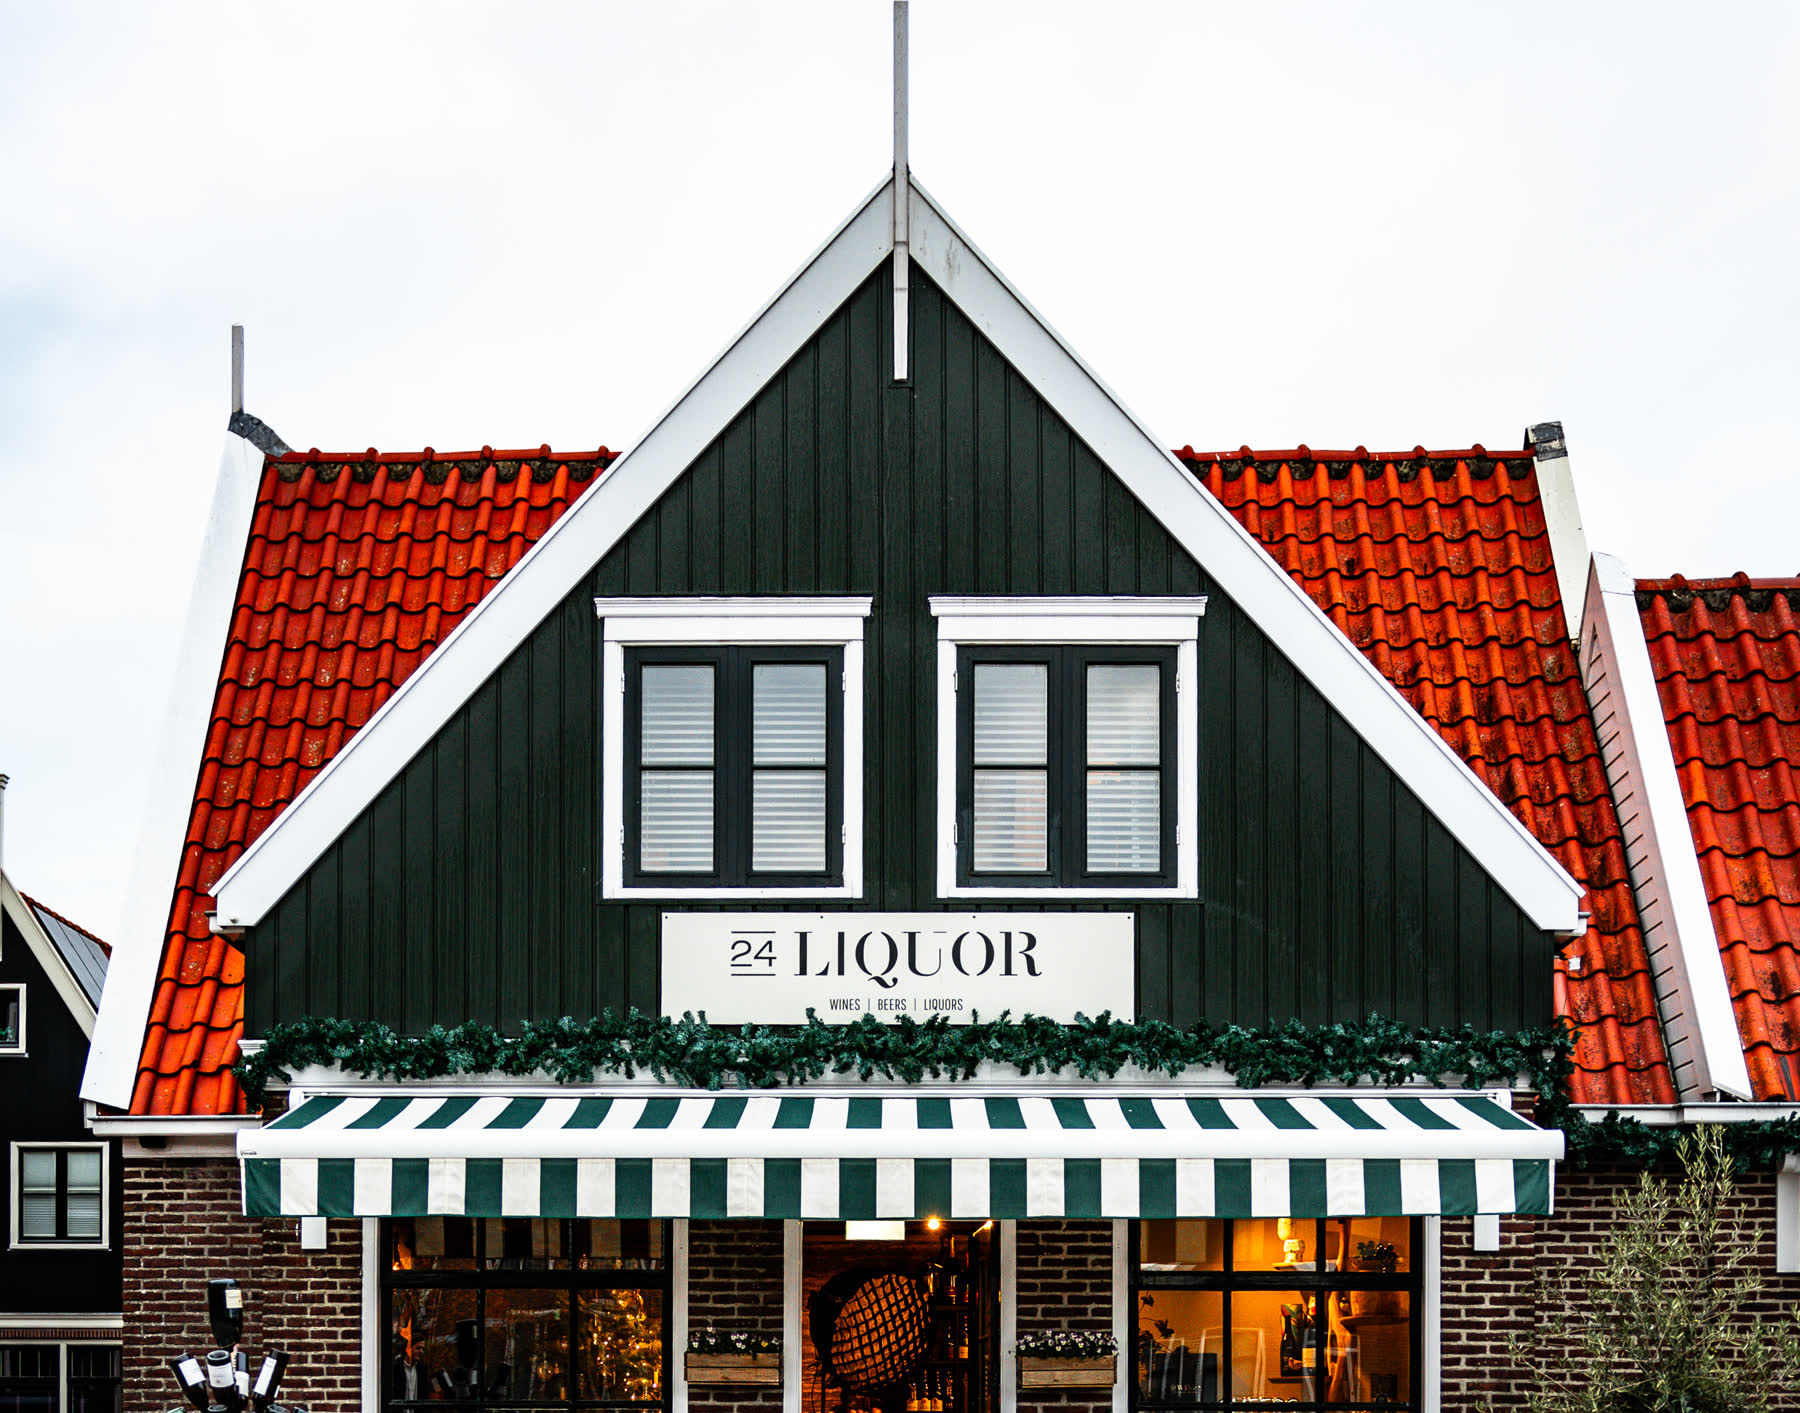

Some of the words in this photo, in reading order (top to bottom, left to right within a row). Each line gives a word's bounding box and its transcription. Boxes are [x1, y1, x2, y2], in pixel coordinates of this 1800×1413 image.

[730, 940, 777, 967] 24
[794, 931, 1042, 989] LIQUOR
[829, 998, 861, 1011] WINES
[877, 998, 907, 1011] BEERS
[923, 998, 963, 1011] LIQUORS
